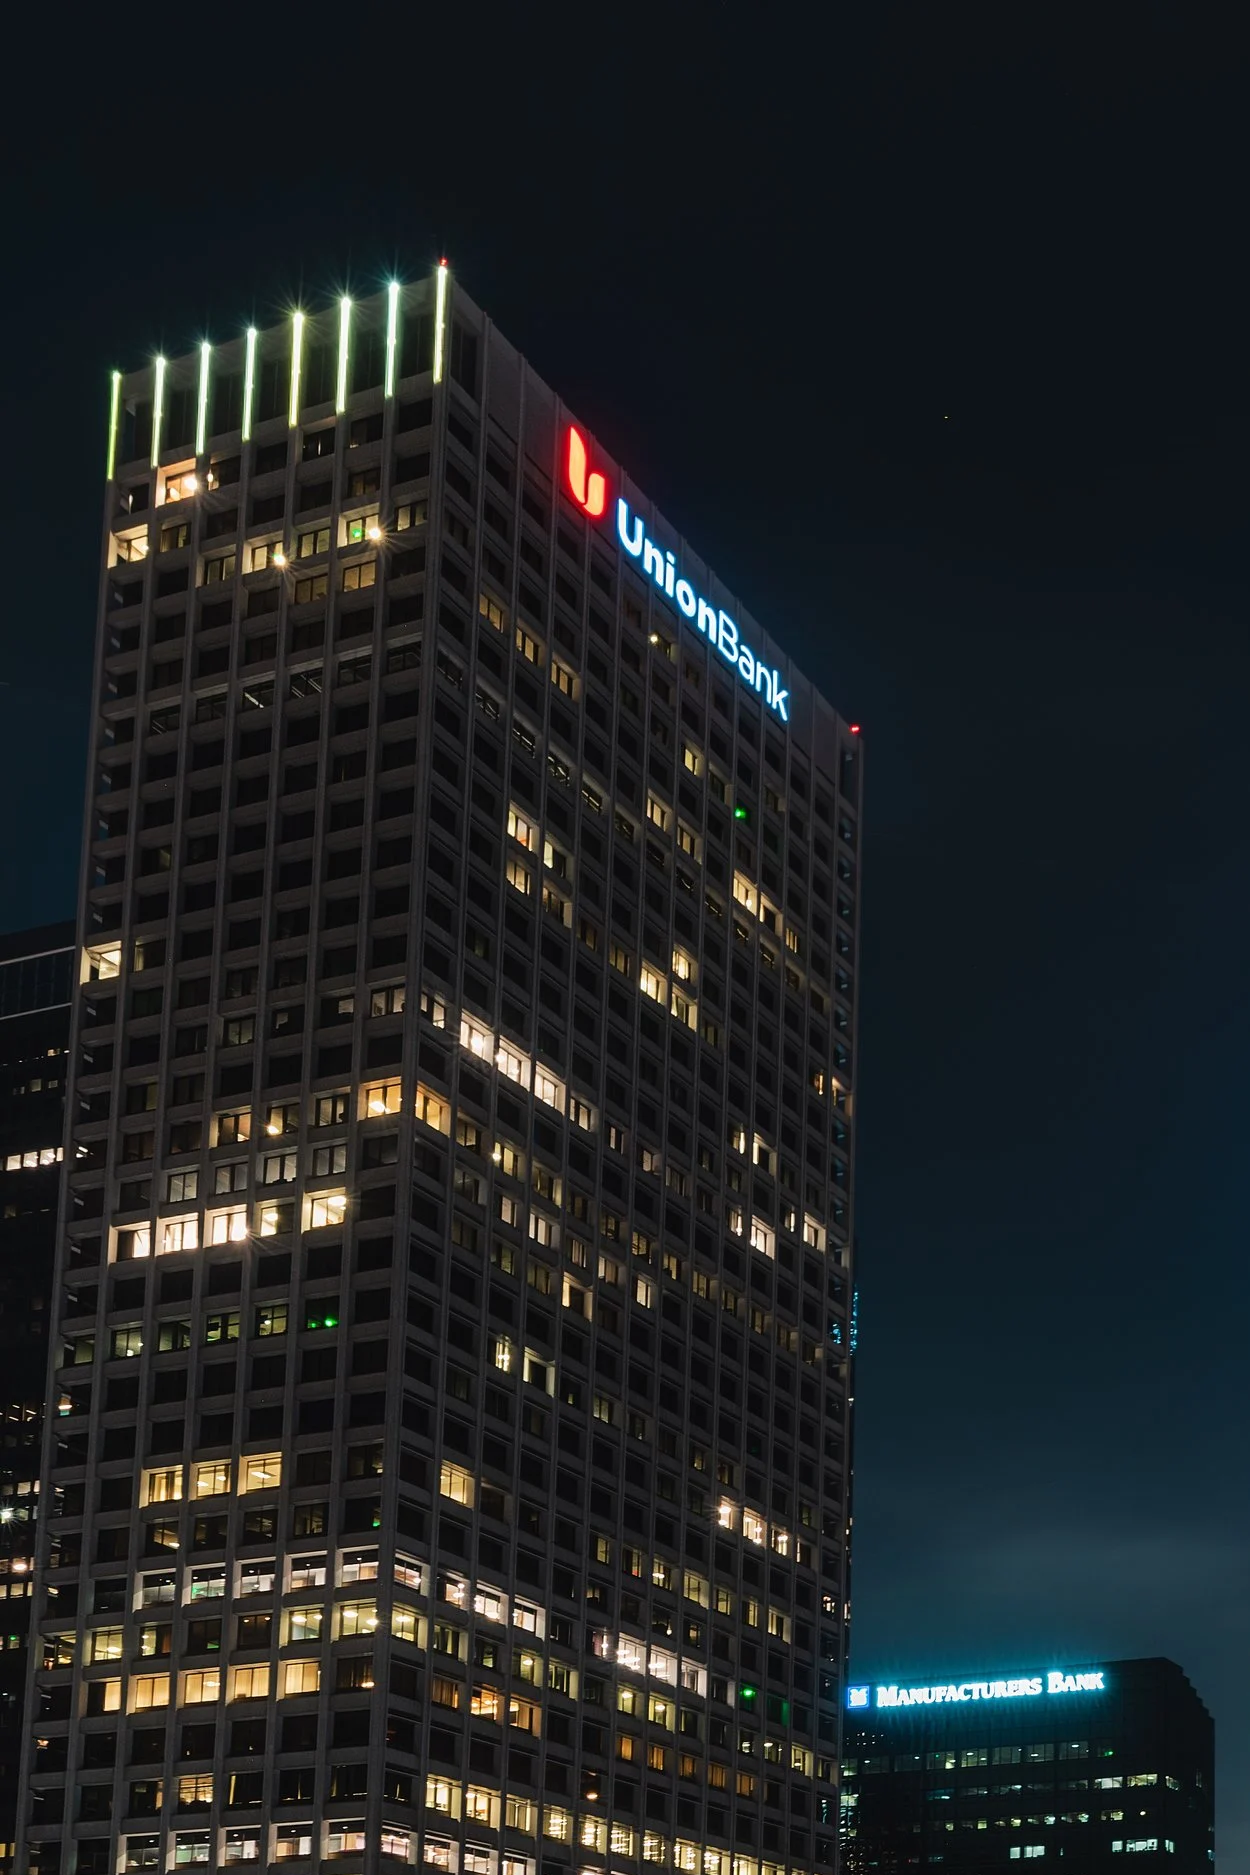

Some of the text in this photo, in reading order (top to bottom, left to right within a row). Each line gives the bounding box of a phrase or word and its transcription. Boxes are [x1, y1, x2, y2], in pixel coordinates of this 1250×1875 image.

[616, 497, 789, 721] UnionBank
[877, 1672, 1104, 1708] MANUFACTURERS BANK
